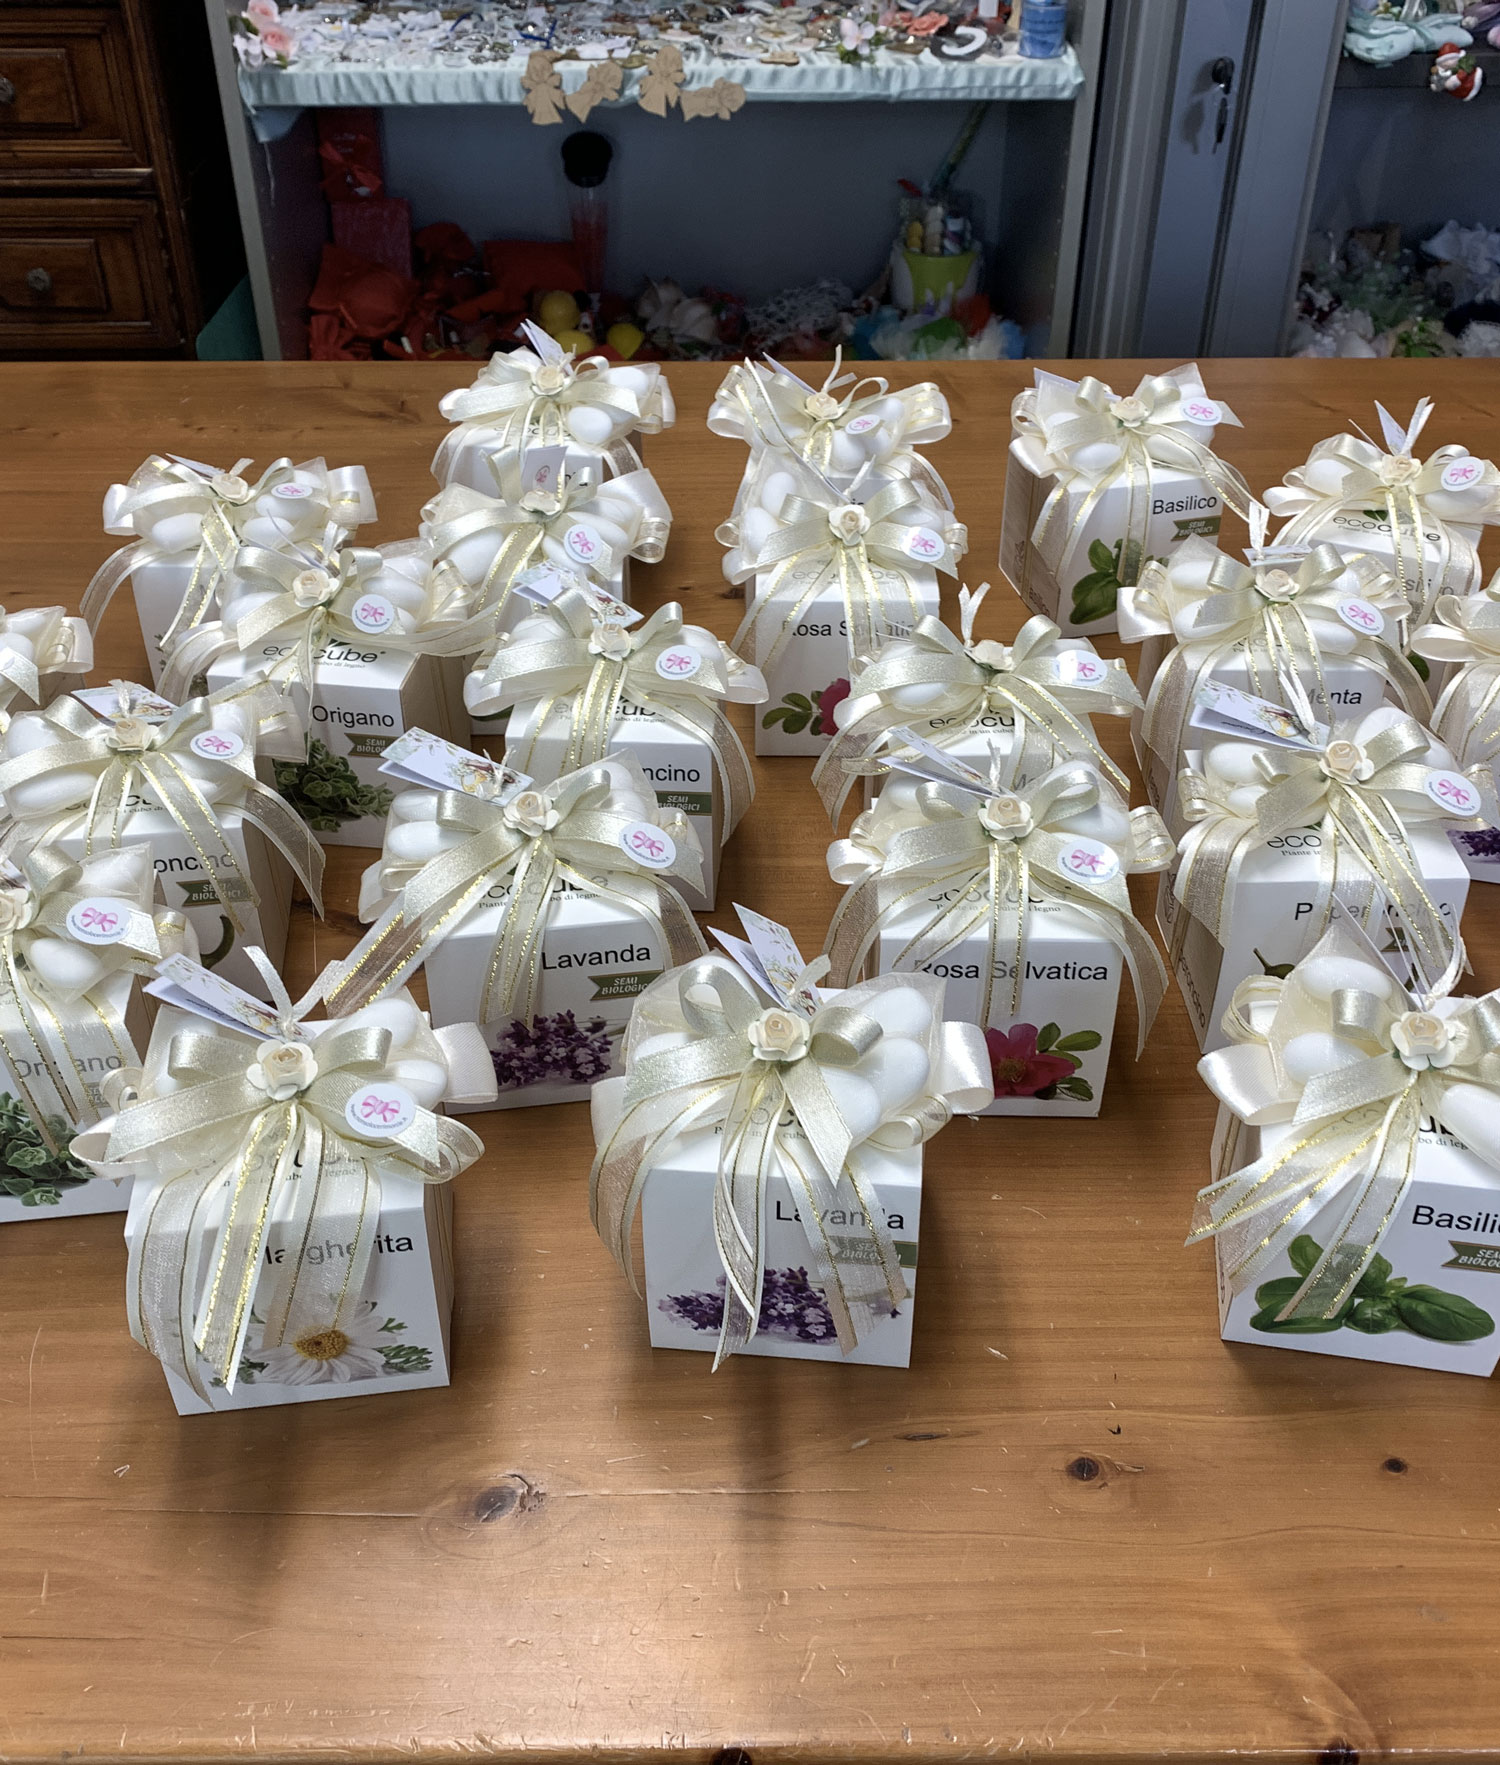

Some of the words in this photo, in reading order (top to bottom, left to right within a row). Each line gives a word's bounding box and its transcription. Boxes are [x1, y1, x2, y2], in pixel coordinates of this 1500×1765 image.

[1152, 495, 1217, 515] Basilico
[312, 704, 395, 728] Origano
[365, 738, 386, 747] SEMI
[667, 795, 689, 804] SEMI
[541, 944, 651, 970] Lavanda
[613, 975, 638, 985] SEMI
[601, 983, 649, 995] BIOLOGIC
[1412, 1204, 1500, 1234] Basili
